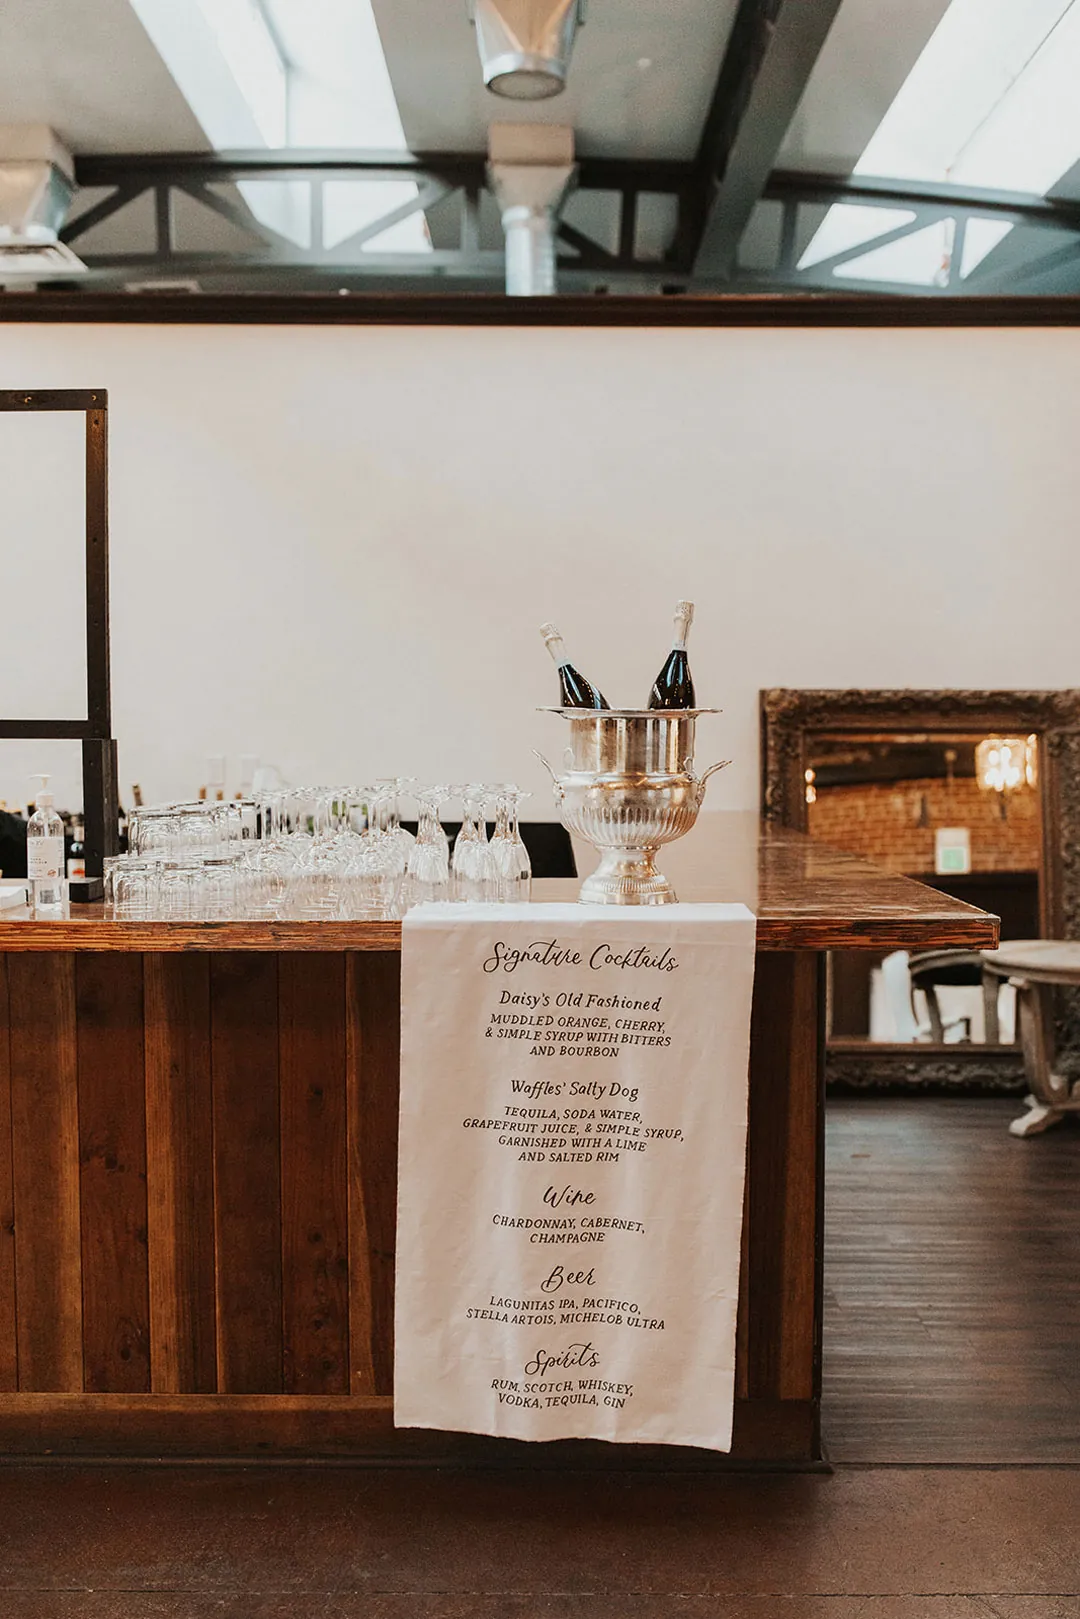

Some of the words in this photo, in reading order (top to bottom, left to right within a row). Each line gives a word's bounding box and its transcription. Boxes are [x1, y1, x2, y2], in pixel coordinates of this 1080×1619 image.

[483, 939, 582, 972] Signature
[590, 944, 678, 971] Cocktails
[500, 991, 550, 1009] Daisy's
[556, 993, 583, 1007] Old
[585, 994, 662, 1012] Fashioned
[491, 1014, 554, 1026] MUDDLED
[558, 1016, 611, 1029] ORANGE,
[615, 1019, 666, 1034] CHERRY,
[485, 1027, 492, 1037] &
[497, 1029, 542, 1041] SIMPLE
[544, 1031, 583, 1042] SYRUP
[587, 1032, 618, 1043] WITH
[621, 1034, 671, 1046] BITTERS
[530, 1046, 555, 1056] AND
[560, 1046, 619, 1057] BOURBON
[512, 1080, 566, 1099] Waffles'
[569, 1082, 606, 1100] Salty
[609, 1083, 638, 1102] Dog
[505, 1106, 561, 1121] TEQUILA,
[563, 1109, 595, 1119] SODA
[600, 1109, 643, 1124] WATER,
[463, 1119, 538, 1133] GRAPEFRUIT
[541, 1124, 580, 1136] JUICE,
[584, 1123, 592, 1132] &
[596, 1124, 640, 1136] SIMPLE
[644, 1129, 684, 1141] SYRUP,
[499, 1135, 567, 1148] GARNISHED
[572, 1138, 602, 1148] WITH
[604, 1138, 612, 1147] A
[616, 1139, 646, 1151] LIME
[518, 1152, 545, 1161] AND
[549, 1152, 592, 1162] SALTED
[596, 1152, 619, 1162] RIM
[543, 1185, 596, 1208] Wine
[493, 1215, 577, 1229] CHARDONNAY,
[581, 1217, 645, 1233] CABERNET,
[530, 1232, 605, 1243] CHAMPAGNE
[541, 1266, 595, 1293] Beer
[489, 1296, 554, 1310] LAGUNITAS
[559, 1299, 579, 1309] IPA,
[466, 1309, 508, 1322] STELLA
[560, 1313, 622, 1324] MICHELOB
[627, 1317, 664, 1329] ULTRA
[525, 1342, 600, 1376] Spirits
[579, 1380, 634, 1396] WHISKEY,
[499, 1393, 543, 1409] VODKA,
[545, 1394, 599, 1407] TEQUILA,
[604, 1396, 625, 1408] GIN
